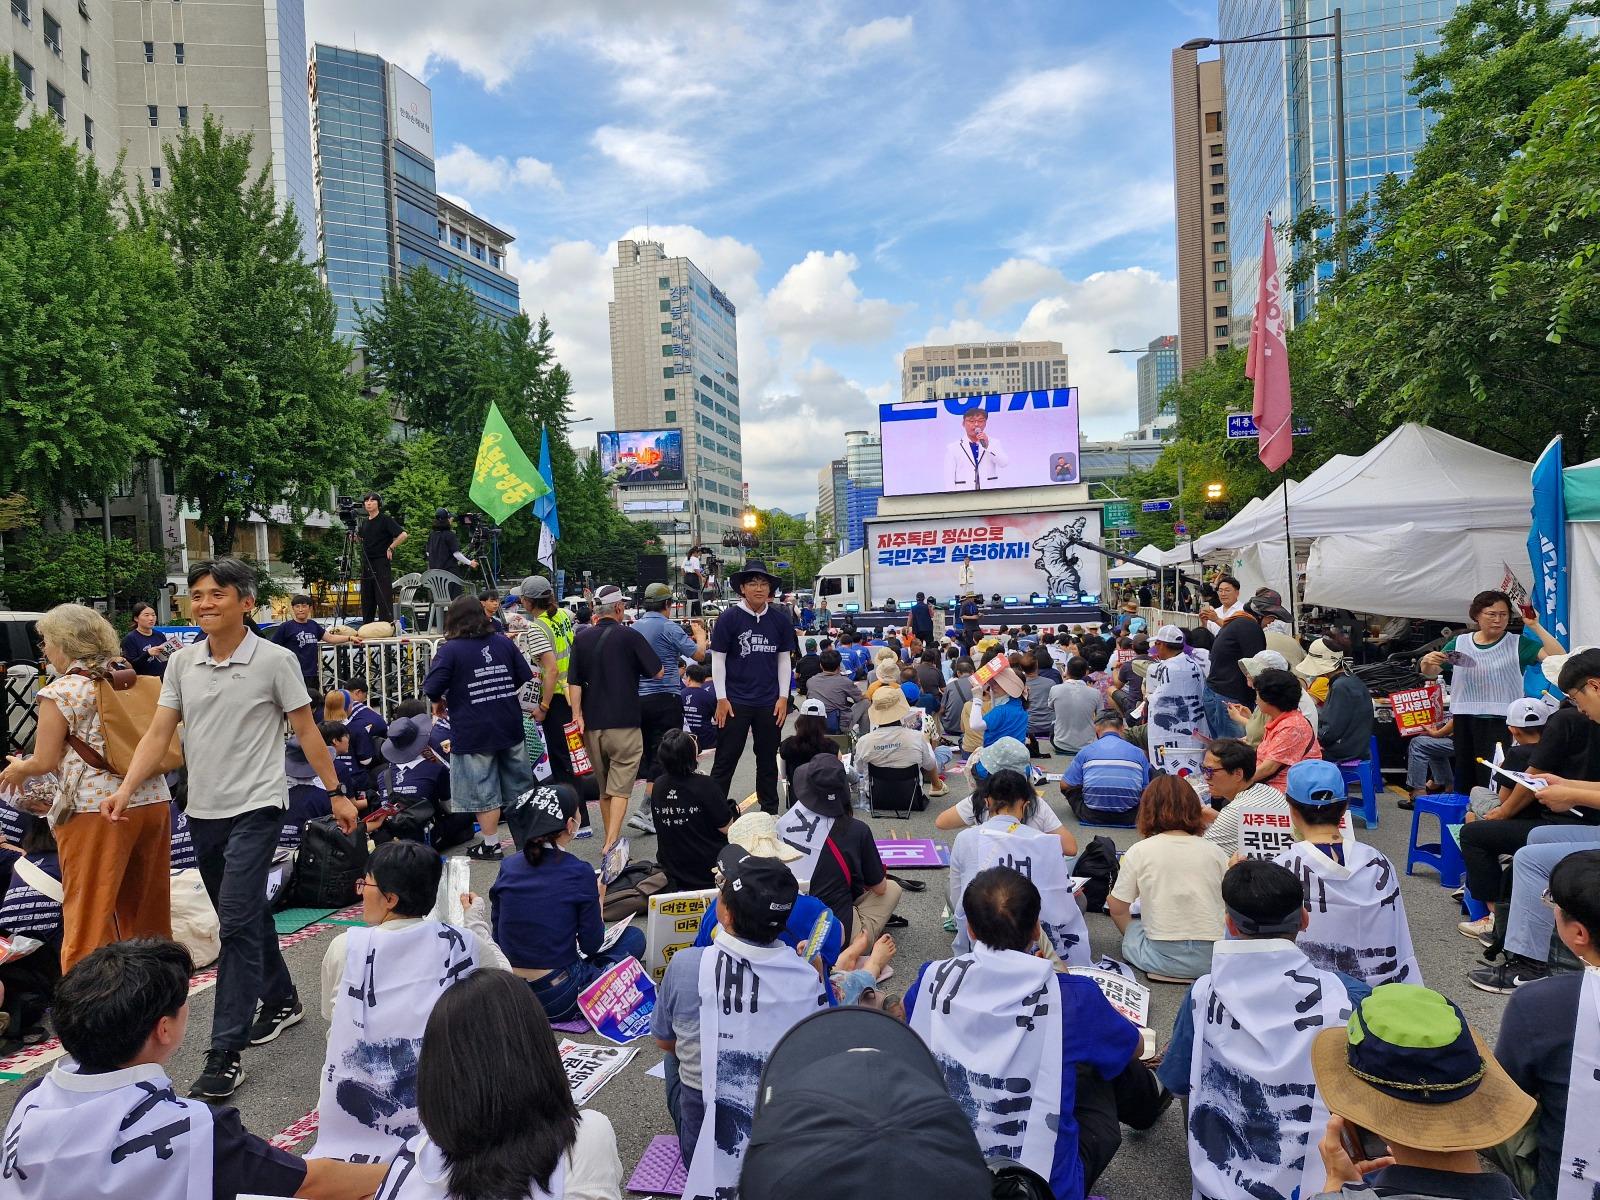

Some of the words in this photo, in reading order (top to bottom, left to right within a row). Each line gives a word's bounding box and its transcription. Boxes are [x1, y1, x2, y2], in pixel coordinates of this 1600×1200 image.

[953, 377, 989, 386] 서울신문
[1231, 417, 1251, 427] 세종
[1231, 429, 1259, 437] Sejong-dae
[877, 530, 937, 548] 자주독립
[942, 526, 1004, 544] 정신으로
[878, 546, 947, 566] 국민주권
[951, 541, 1030, 563] 실현하자!
[525, 680, 543, 692] 국민
[523, 692, 543, 704] 실현
[1392, 690, 1429, 705] 한미연합
[1395, 699, 1431, 714] 군사훈련
[1402, 710, 1431, 727] 중단!
[874, 743, 901, 751] together
[1243, 813, 1290, 828] 자주독립
[1244, 831, 1295, 850] 국민주
[662, 903, 687, 913] 대한
[677, 918, 699, 930] 미국
[589, 959, 642, 1022] 내란행위자
[611, 981, 644, 1021] 처벌
